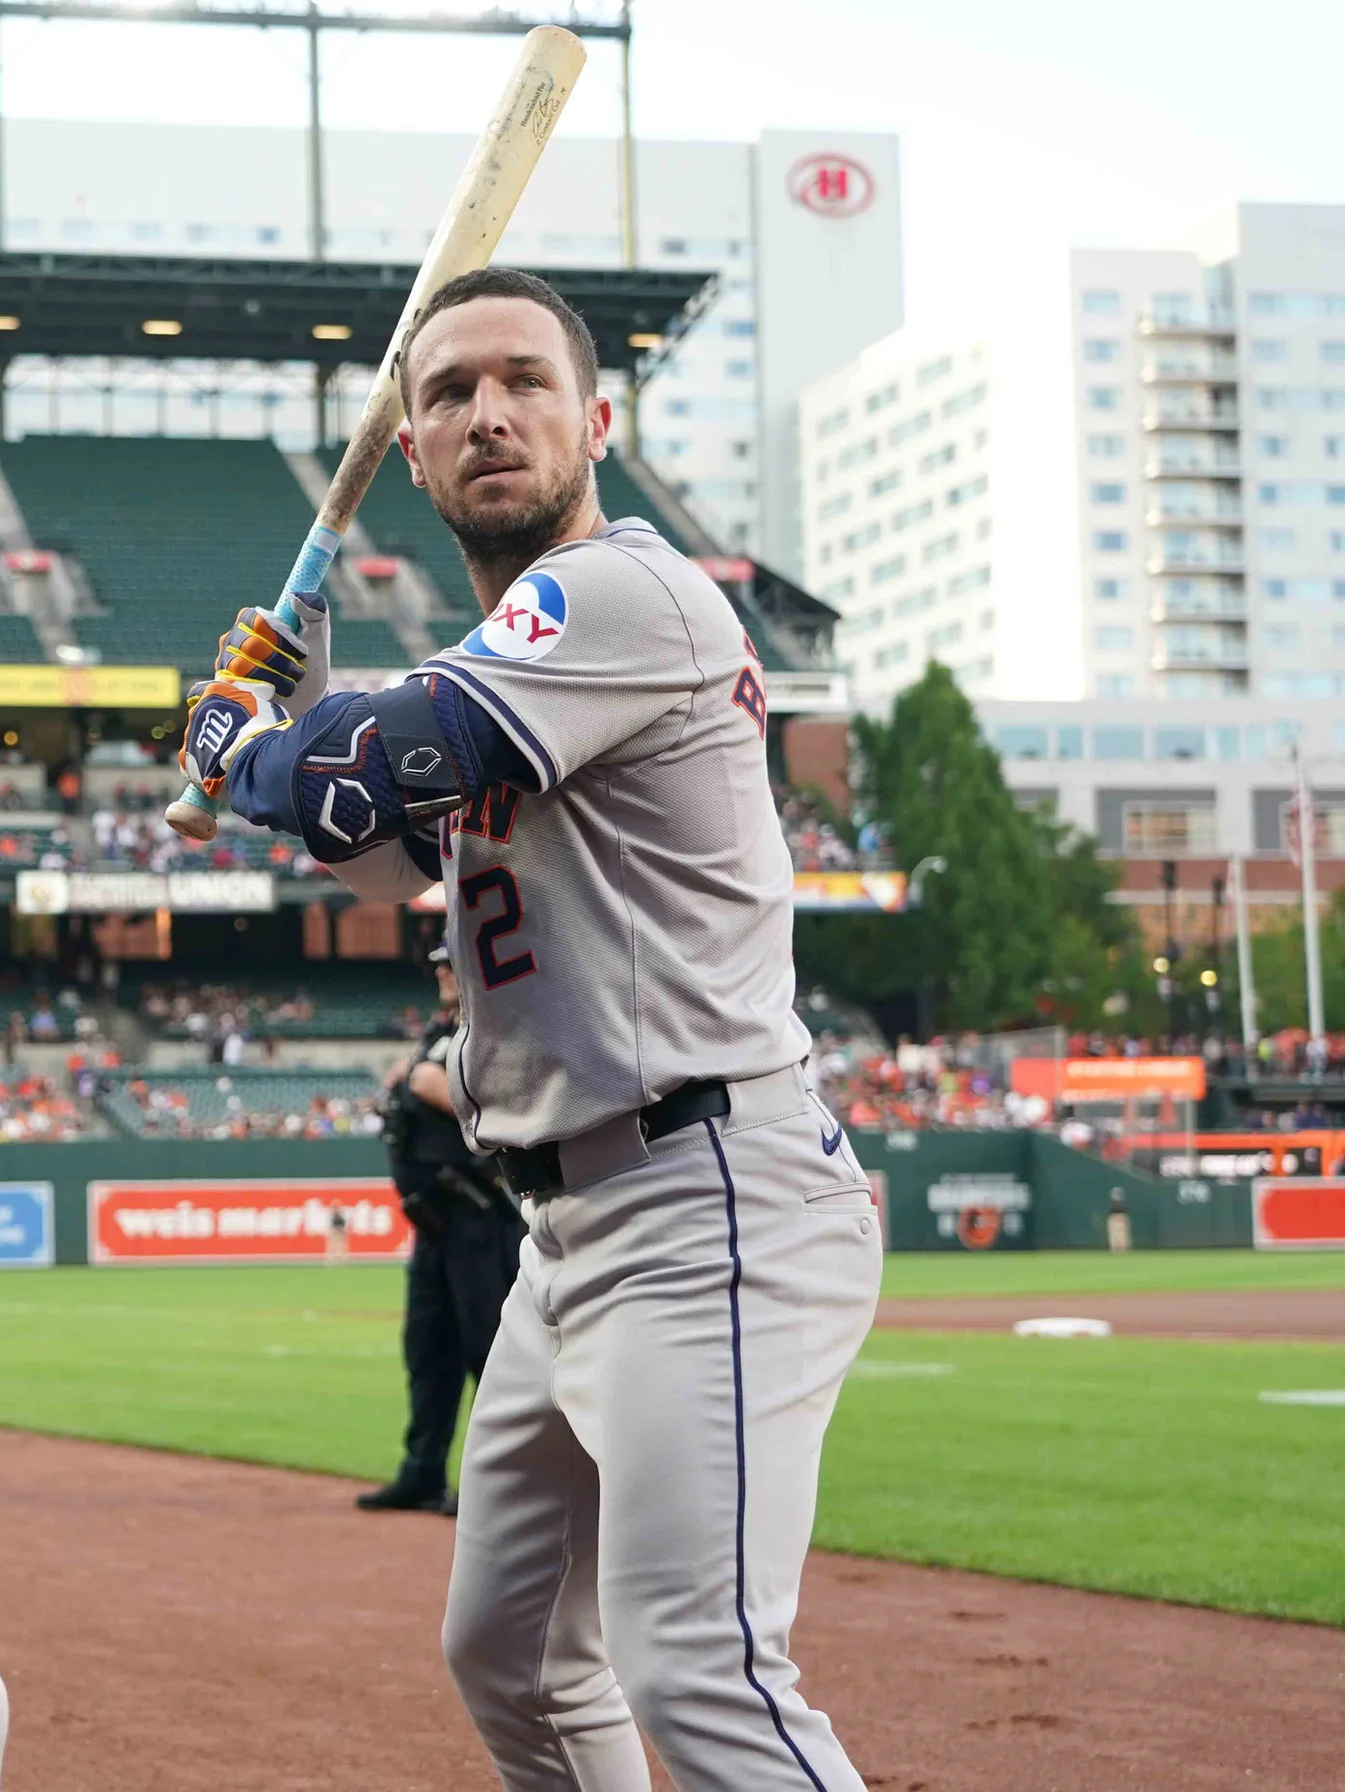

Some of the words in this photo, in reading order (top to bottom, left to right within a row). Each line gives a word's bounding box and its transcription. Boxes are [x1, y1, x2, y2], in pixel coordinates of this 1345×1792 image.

[520, 91, 541, 128] Handcrafted
[458, 864, 537, 991] 2
[114, 1200, 216, 1238] weis
